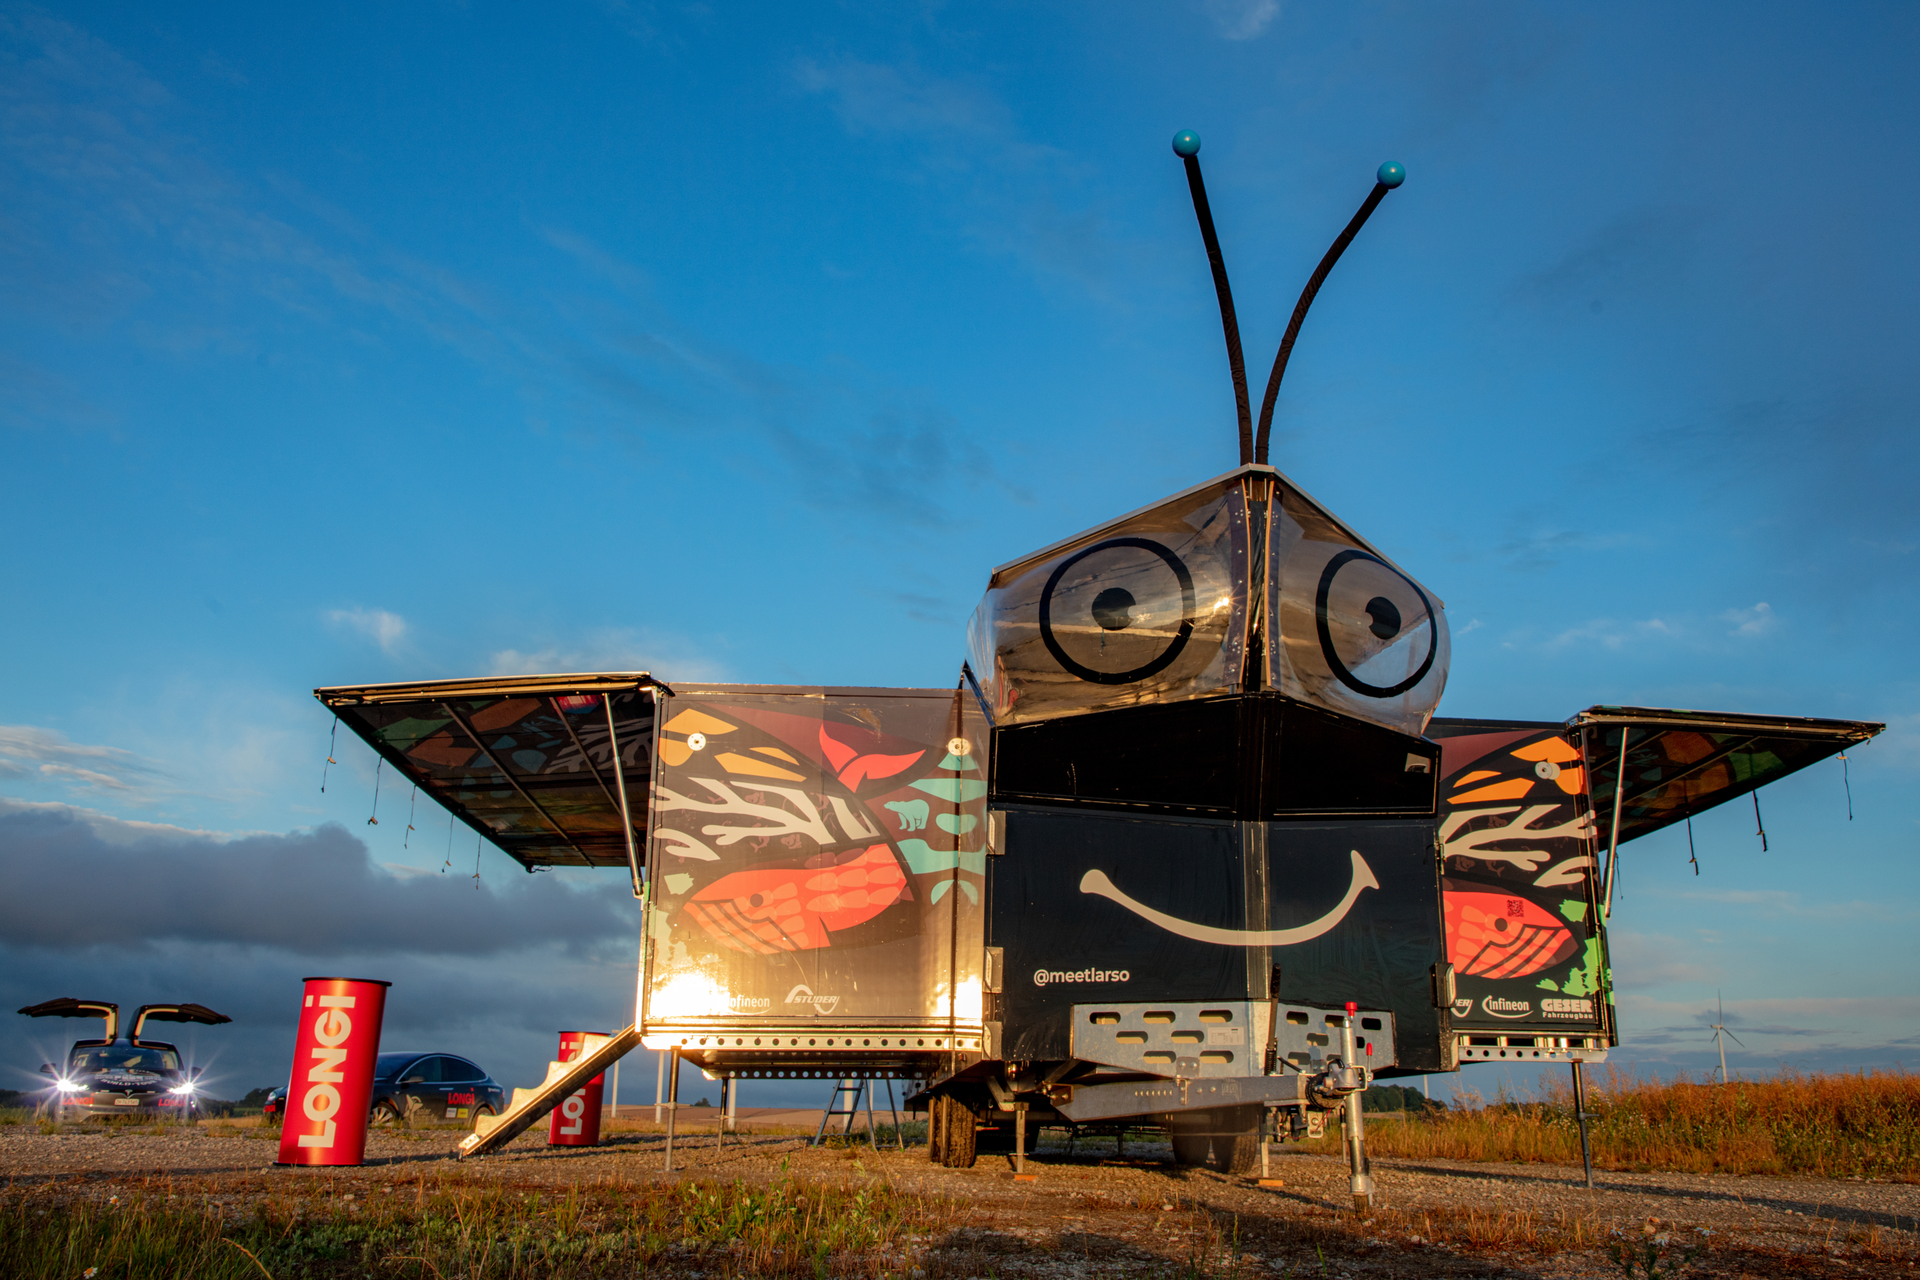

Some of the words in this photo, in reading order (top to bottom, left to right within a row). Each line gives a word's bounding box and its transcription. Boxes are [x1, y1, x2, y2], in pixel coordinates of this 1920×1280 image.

[1033, 967, 1130, 987] @meetlarso
[728, 994, 770, 1008] nfineon
[1540, 998, 1593, 1013] GESER
[1542, 1011, 1594, 1020] Fahrzeugbau
